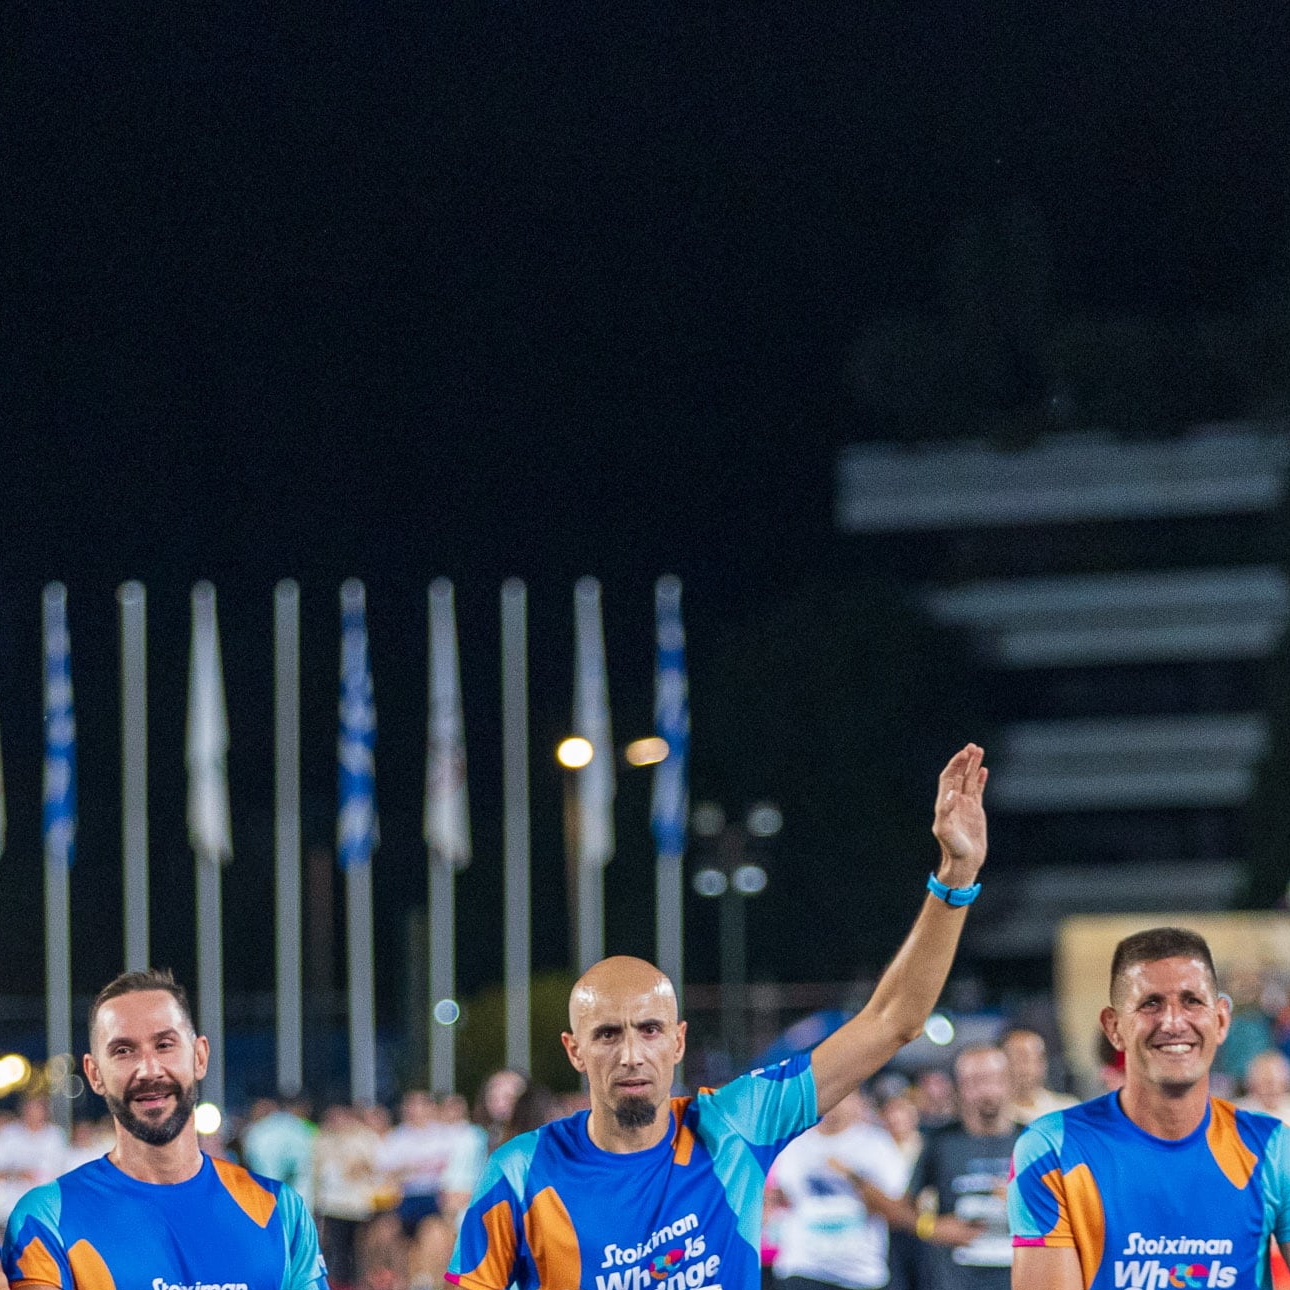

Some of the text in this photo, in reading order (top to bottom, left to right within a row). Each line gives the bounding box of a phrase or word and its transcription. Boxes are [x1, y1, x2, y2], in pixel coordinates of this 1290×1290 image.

[601, 1213, 699, 1269] Stoiximan
[1122, 1232, 1234, 1255] Stoiximan
[1114, 1260, 1238, 1289] Wheels
